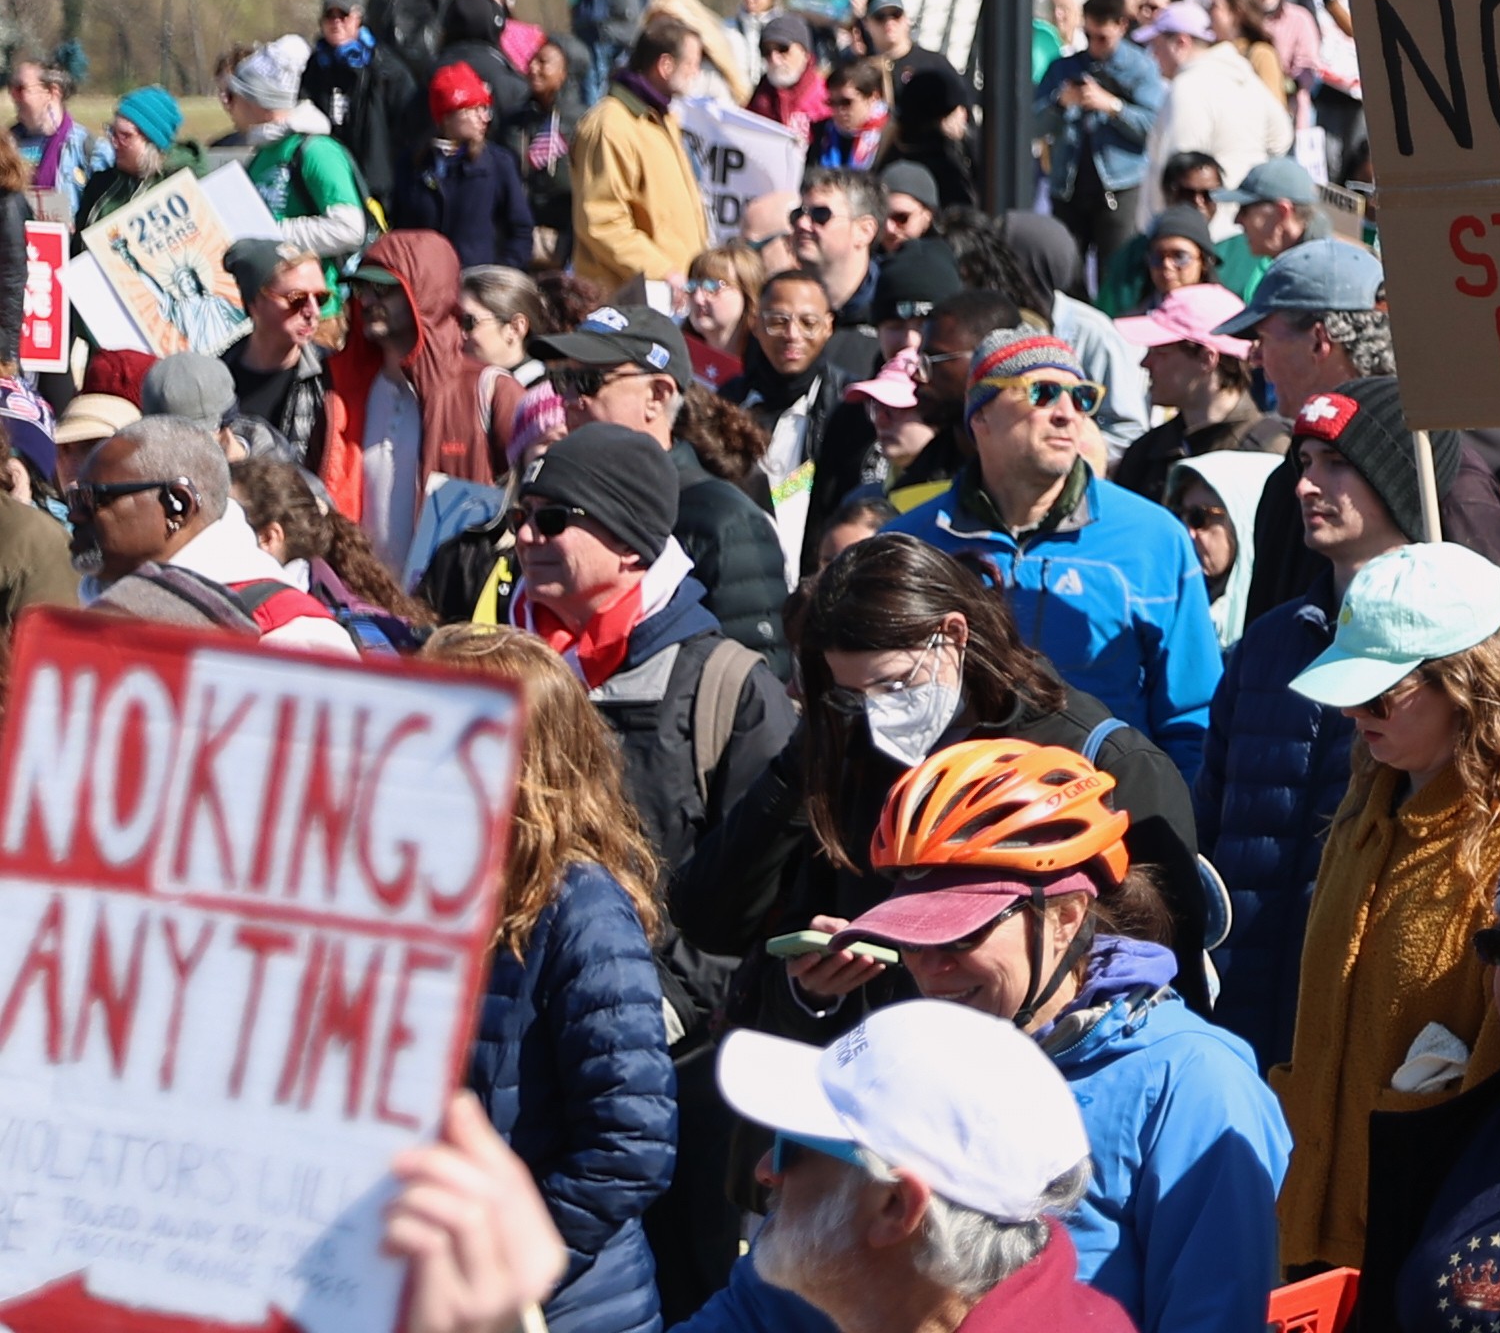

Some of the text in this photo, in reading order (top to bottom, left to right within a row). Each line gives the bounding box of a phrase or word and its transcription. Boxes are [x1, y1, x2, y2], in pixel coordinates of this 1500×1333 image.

[129, 194, 190, 244] 250
[144, 220, 198, 255] YEARS
[3, 662, 512, 922] NO KINGS
[1064, 776, 1101, 800] GIRO
[0, 894, 461, 1129] ANYTIME
[0, 1117, 240, 1208] VIOLATORS
